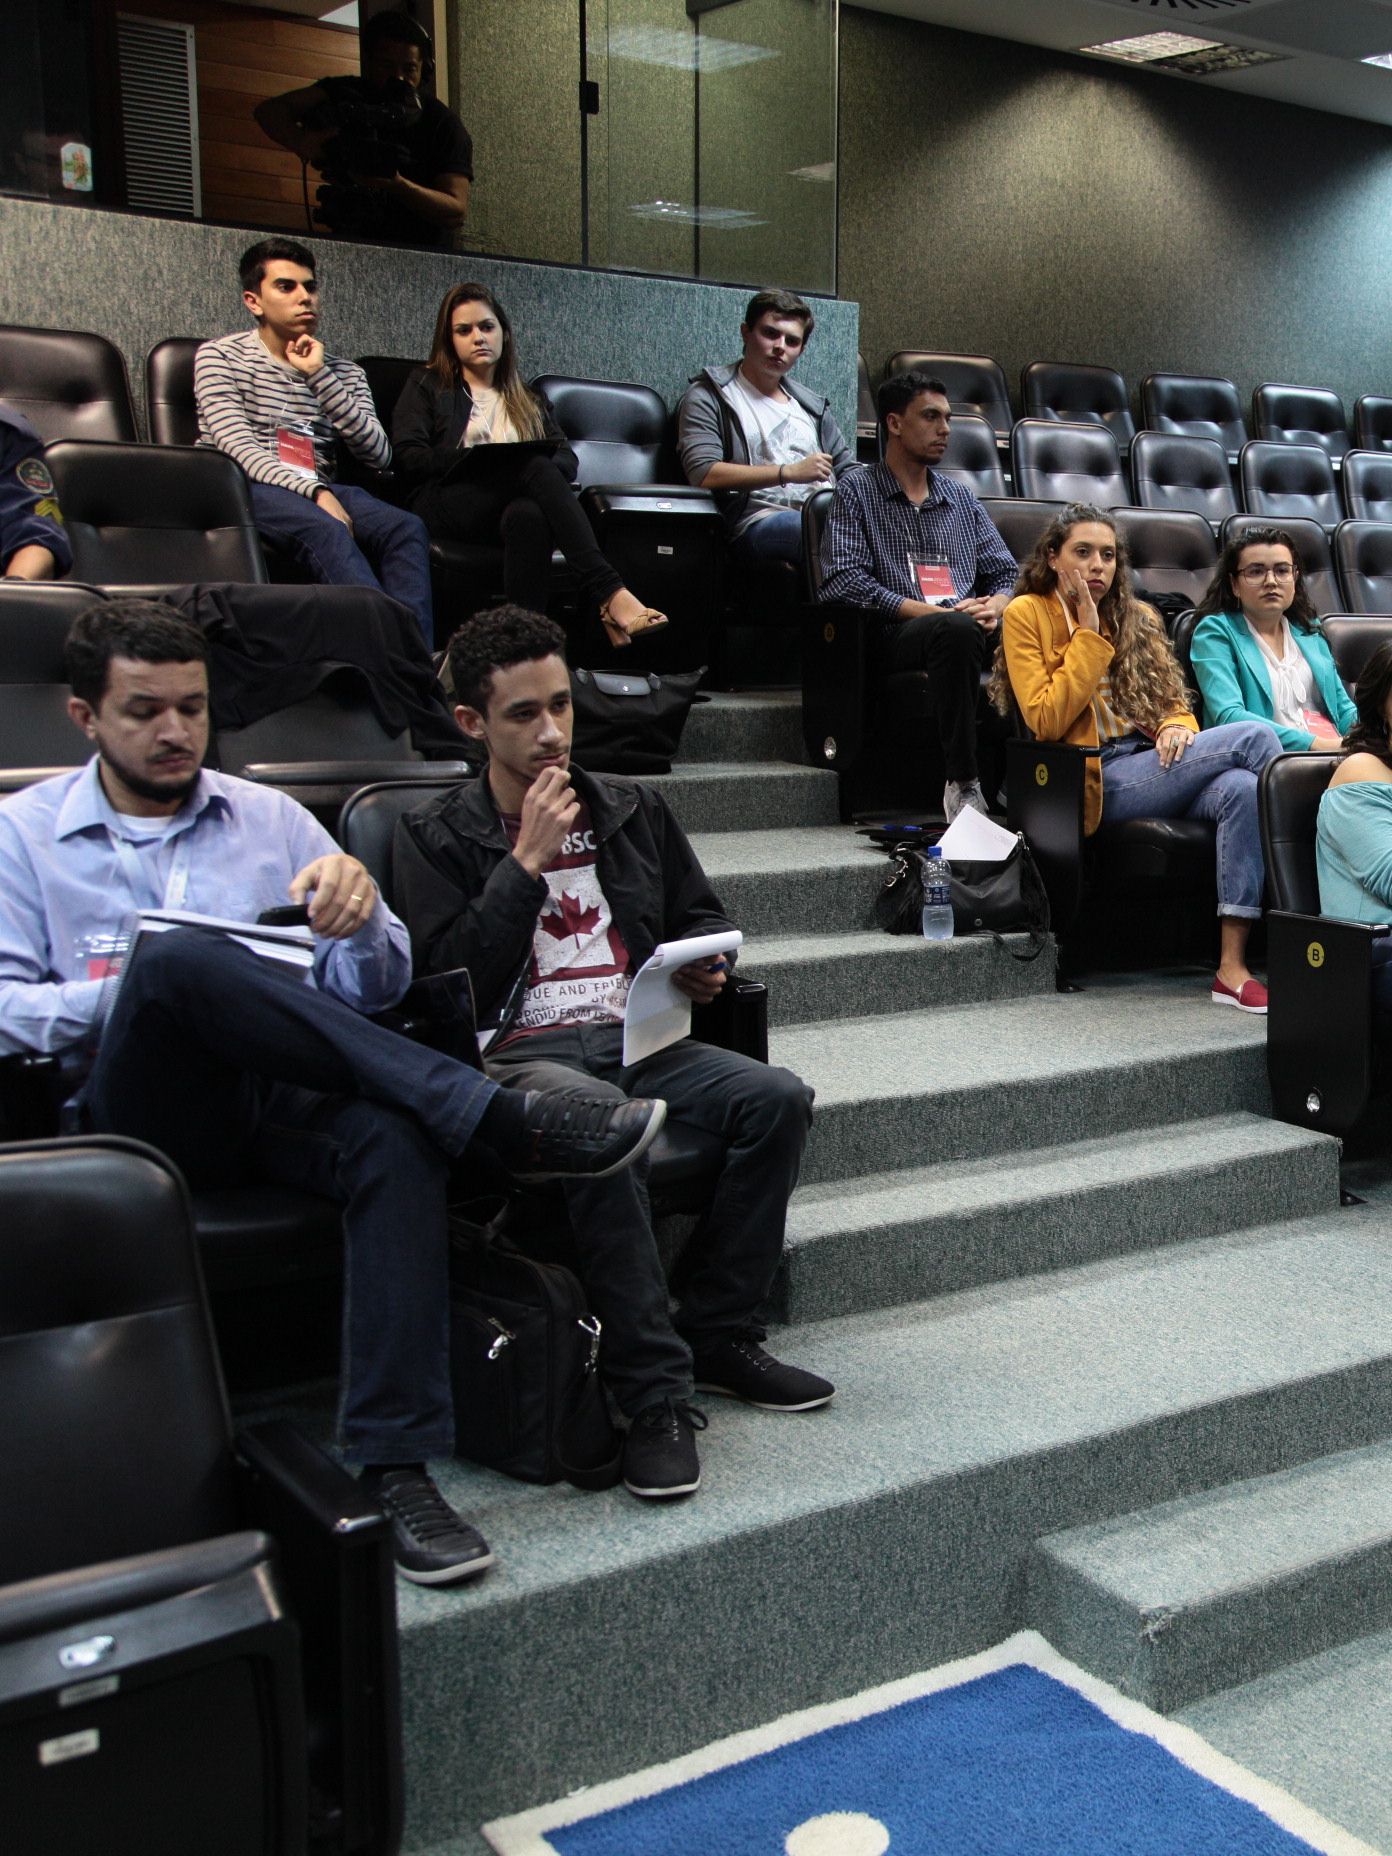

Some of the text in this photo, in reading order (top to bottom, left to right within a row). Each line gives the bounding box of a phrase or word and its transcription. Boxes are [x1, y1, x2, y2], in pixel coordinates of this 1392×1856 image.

[1039, 769, 1045, 780] C
[1312, 948, 1320, 961] B
[559, 984, 587, 996] AND
[559, 1008, 591, 1020] FROM
